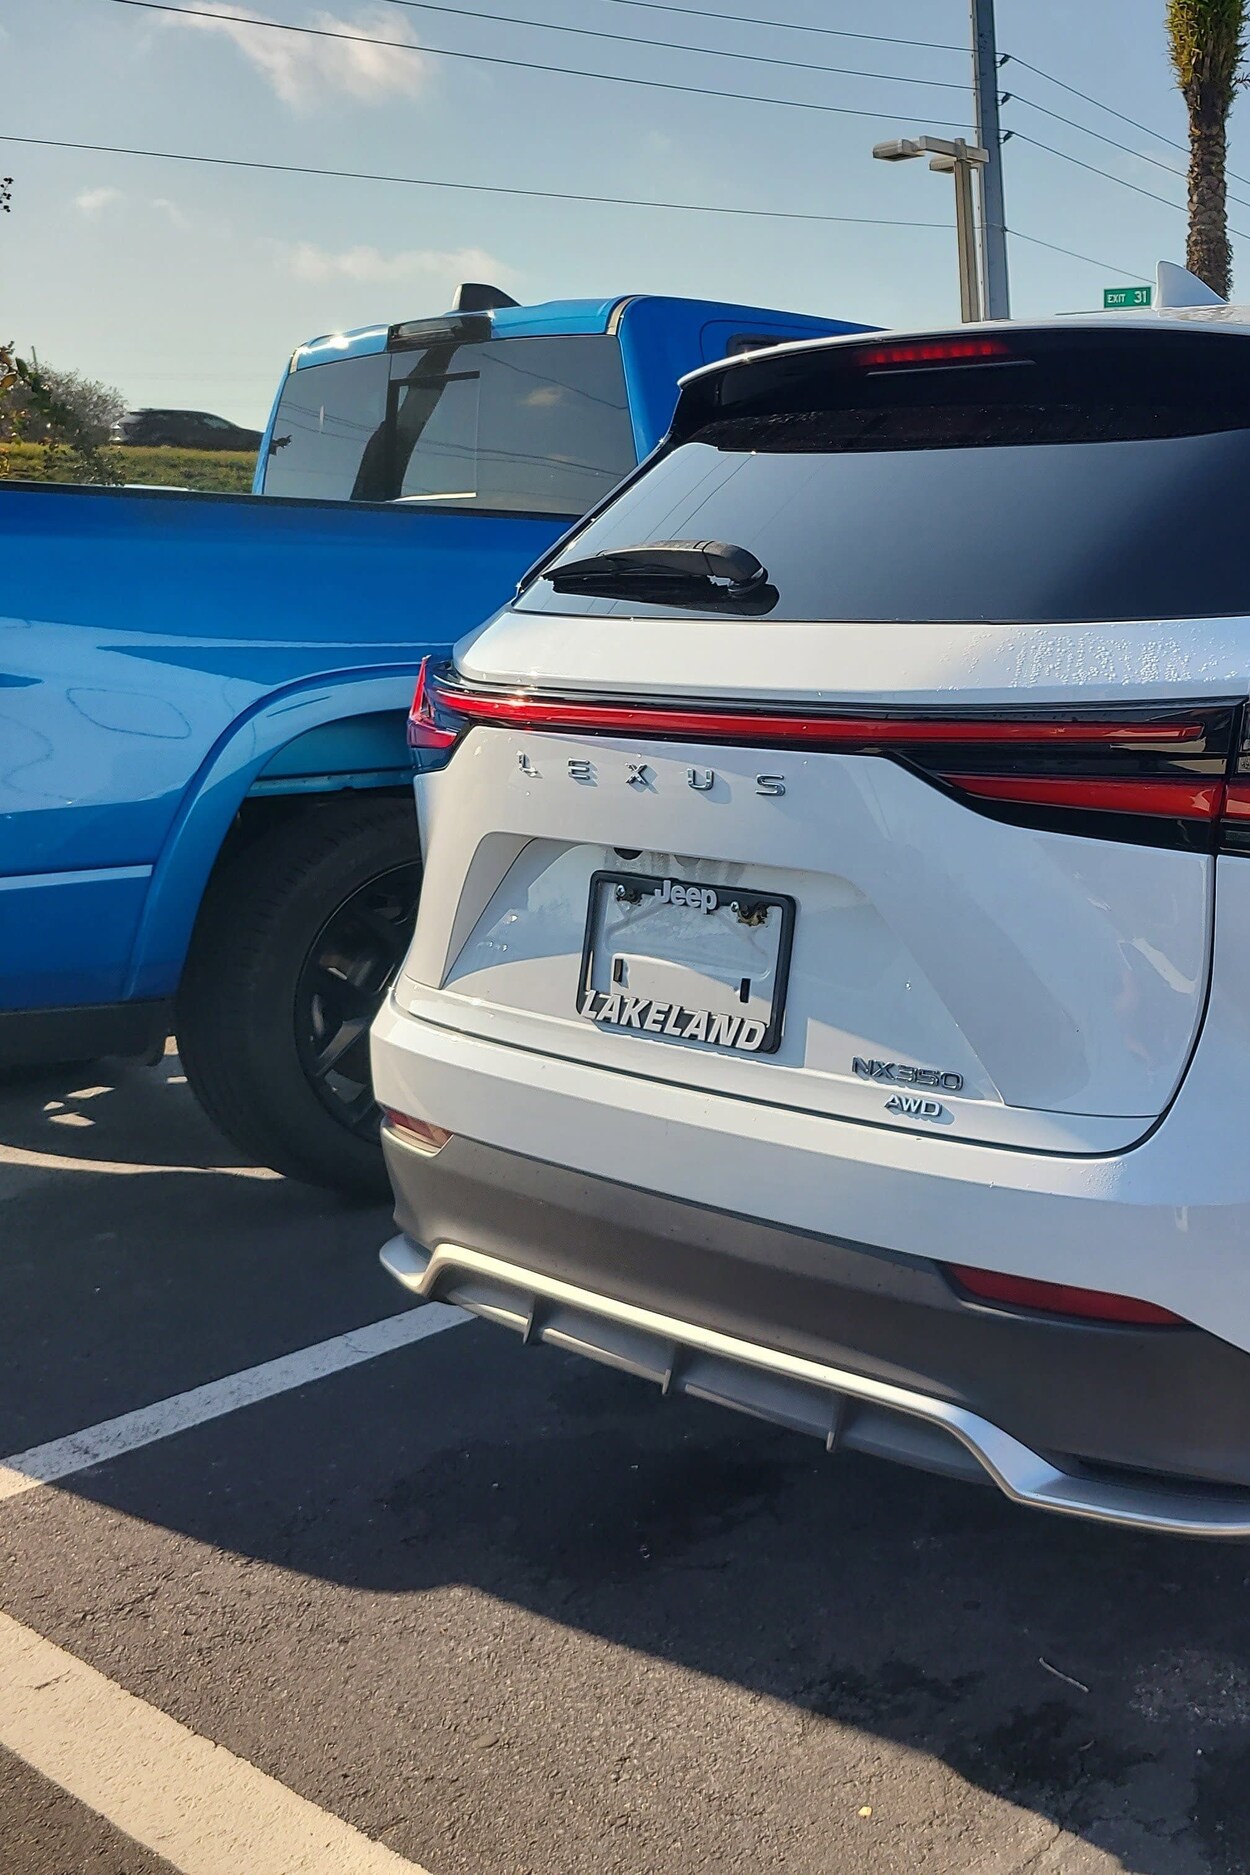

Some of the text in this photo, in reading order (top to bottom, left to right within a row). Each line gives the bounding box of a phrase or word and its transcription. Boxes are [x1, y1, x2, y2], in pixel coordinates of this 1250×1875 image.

[1107, 290, 1147, 303] EXIT 31
[516, 750, 786, 796] LEXUS
[654, 879, 719, 914] Jeep
[580, 989, 767, 1051] LAKELAND
[851, 1055, 964, 1091] NX350
[884, 1094, 942, 1117] AWD
